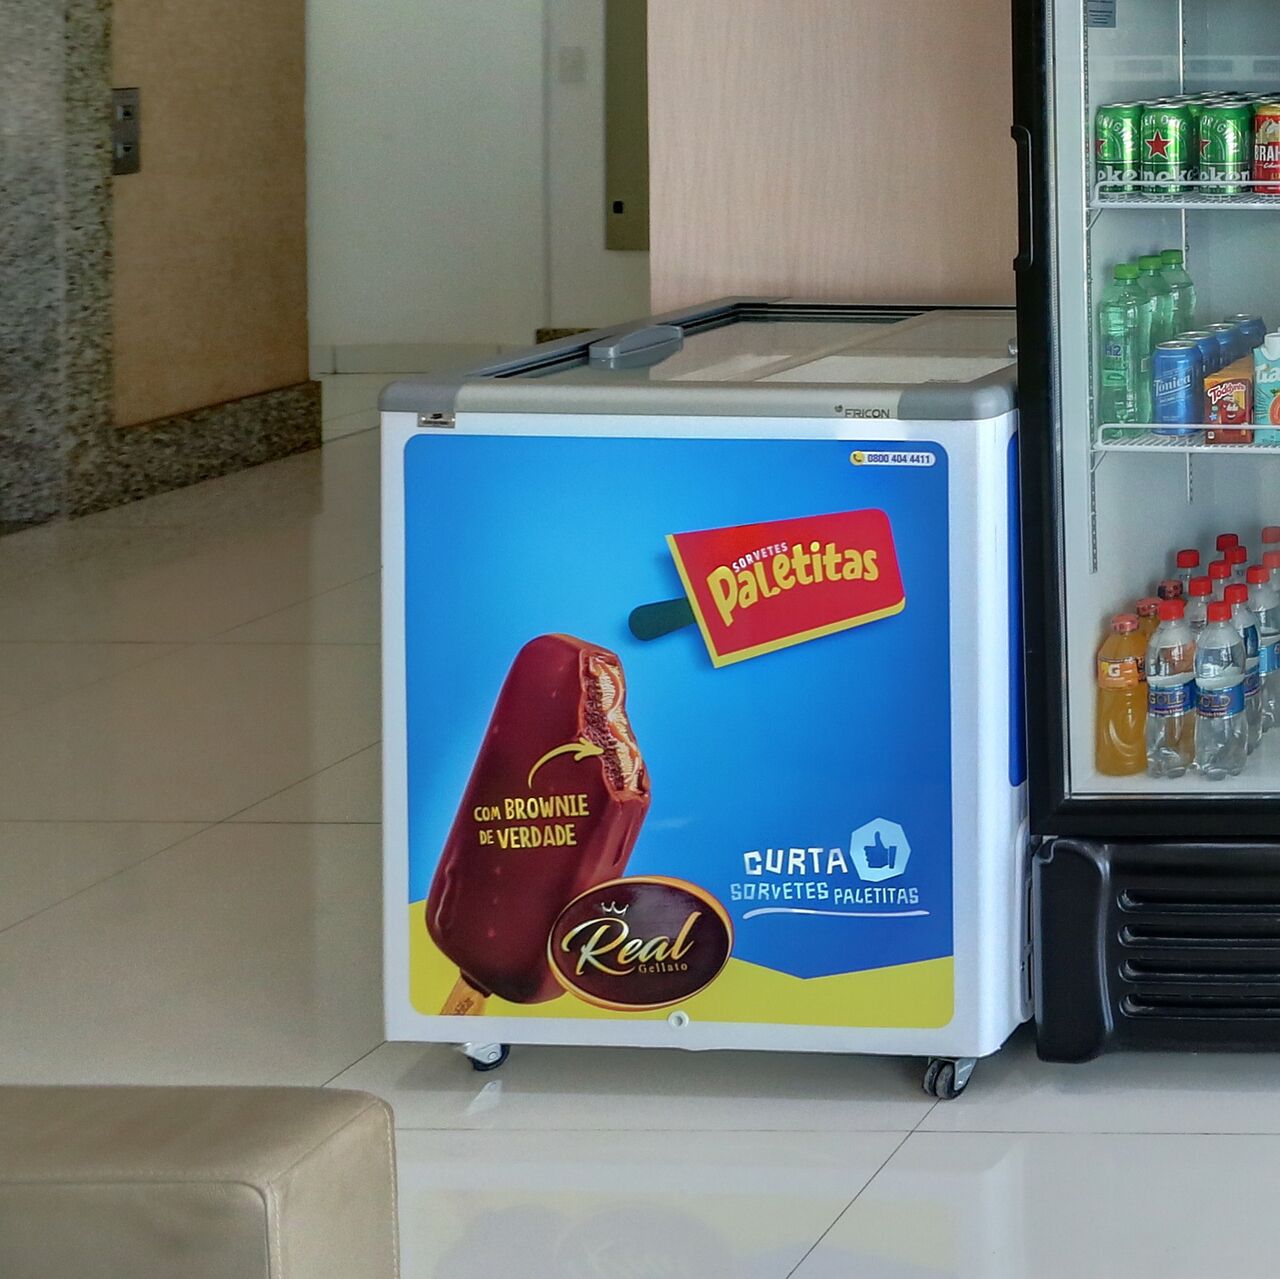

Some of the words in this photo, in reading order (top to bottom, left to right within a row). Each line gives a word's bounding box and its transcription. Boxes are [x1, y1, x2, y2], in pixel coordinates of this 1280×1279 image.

[844, 408, 890, 419] FRICON
[867, 453, 889, 464] 0800
[890, 453, 908, 464] 404
[910, 454, 932, 464] 4411
[731, 541, 789, 573] SORVETES
[1107, 663, 1121, 677] G
[1198, 694, 1232, 708] OLD
[473, 804, 501, 822] COM
[503, 794, 590, 821] BROWNIE
[479, 829, 495, 846] DE
[496, 823, 578, 849] VERDADE
[743, 847, 849, 877] CURTA
[730, 881, 830, 902] SORVETES
[833, 886, 920, 906] PALETITAS
[561, 910, 703, 978] Real
[637, 962, 689, 975] Gellato
